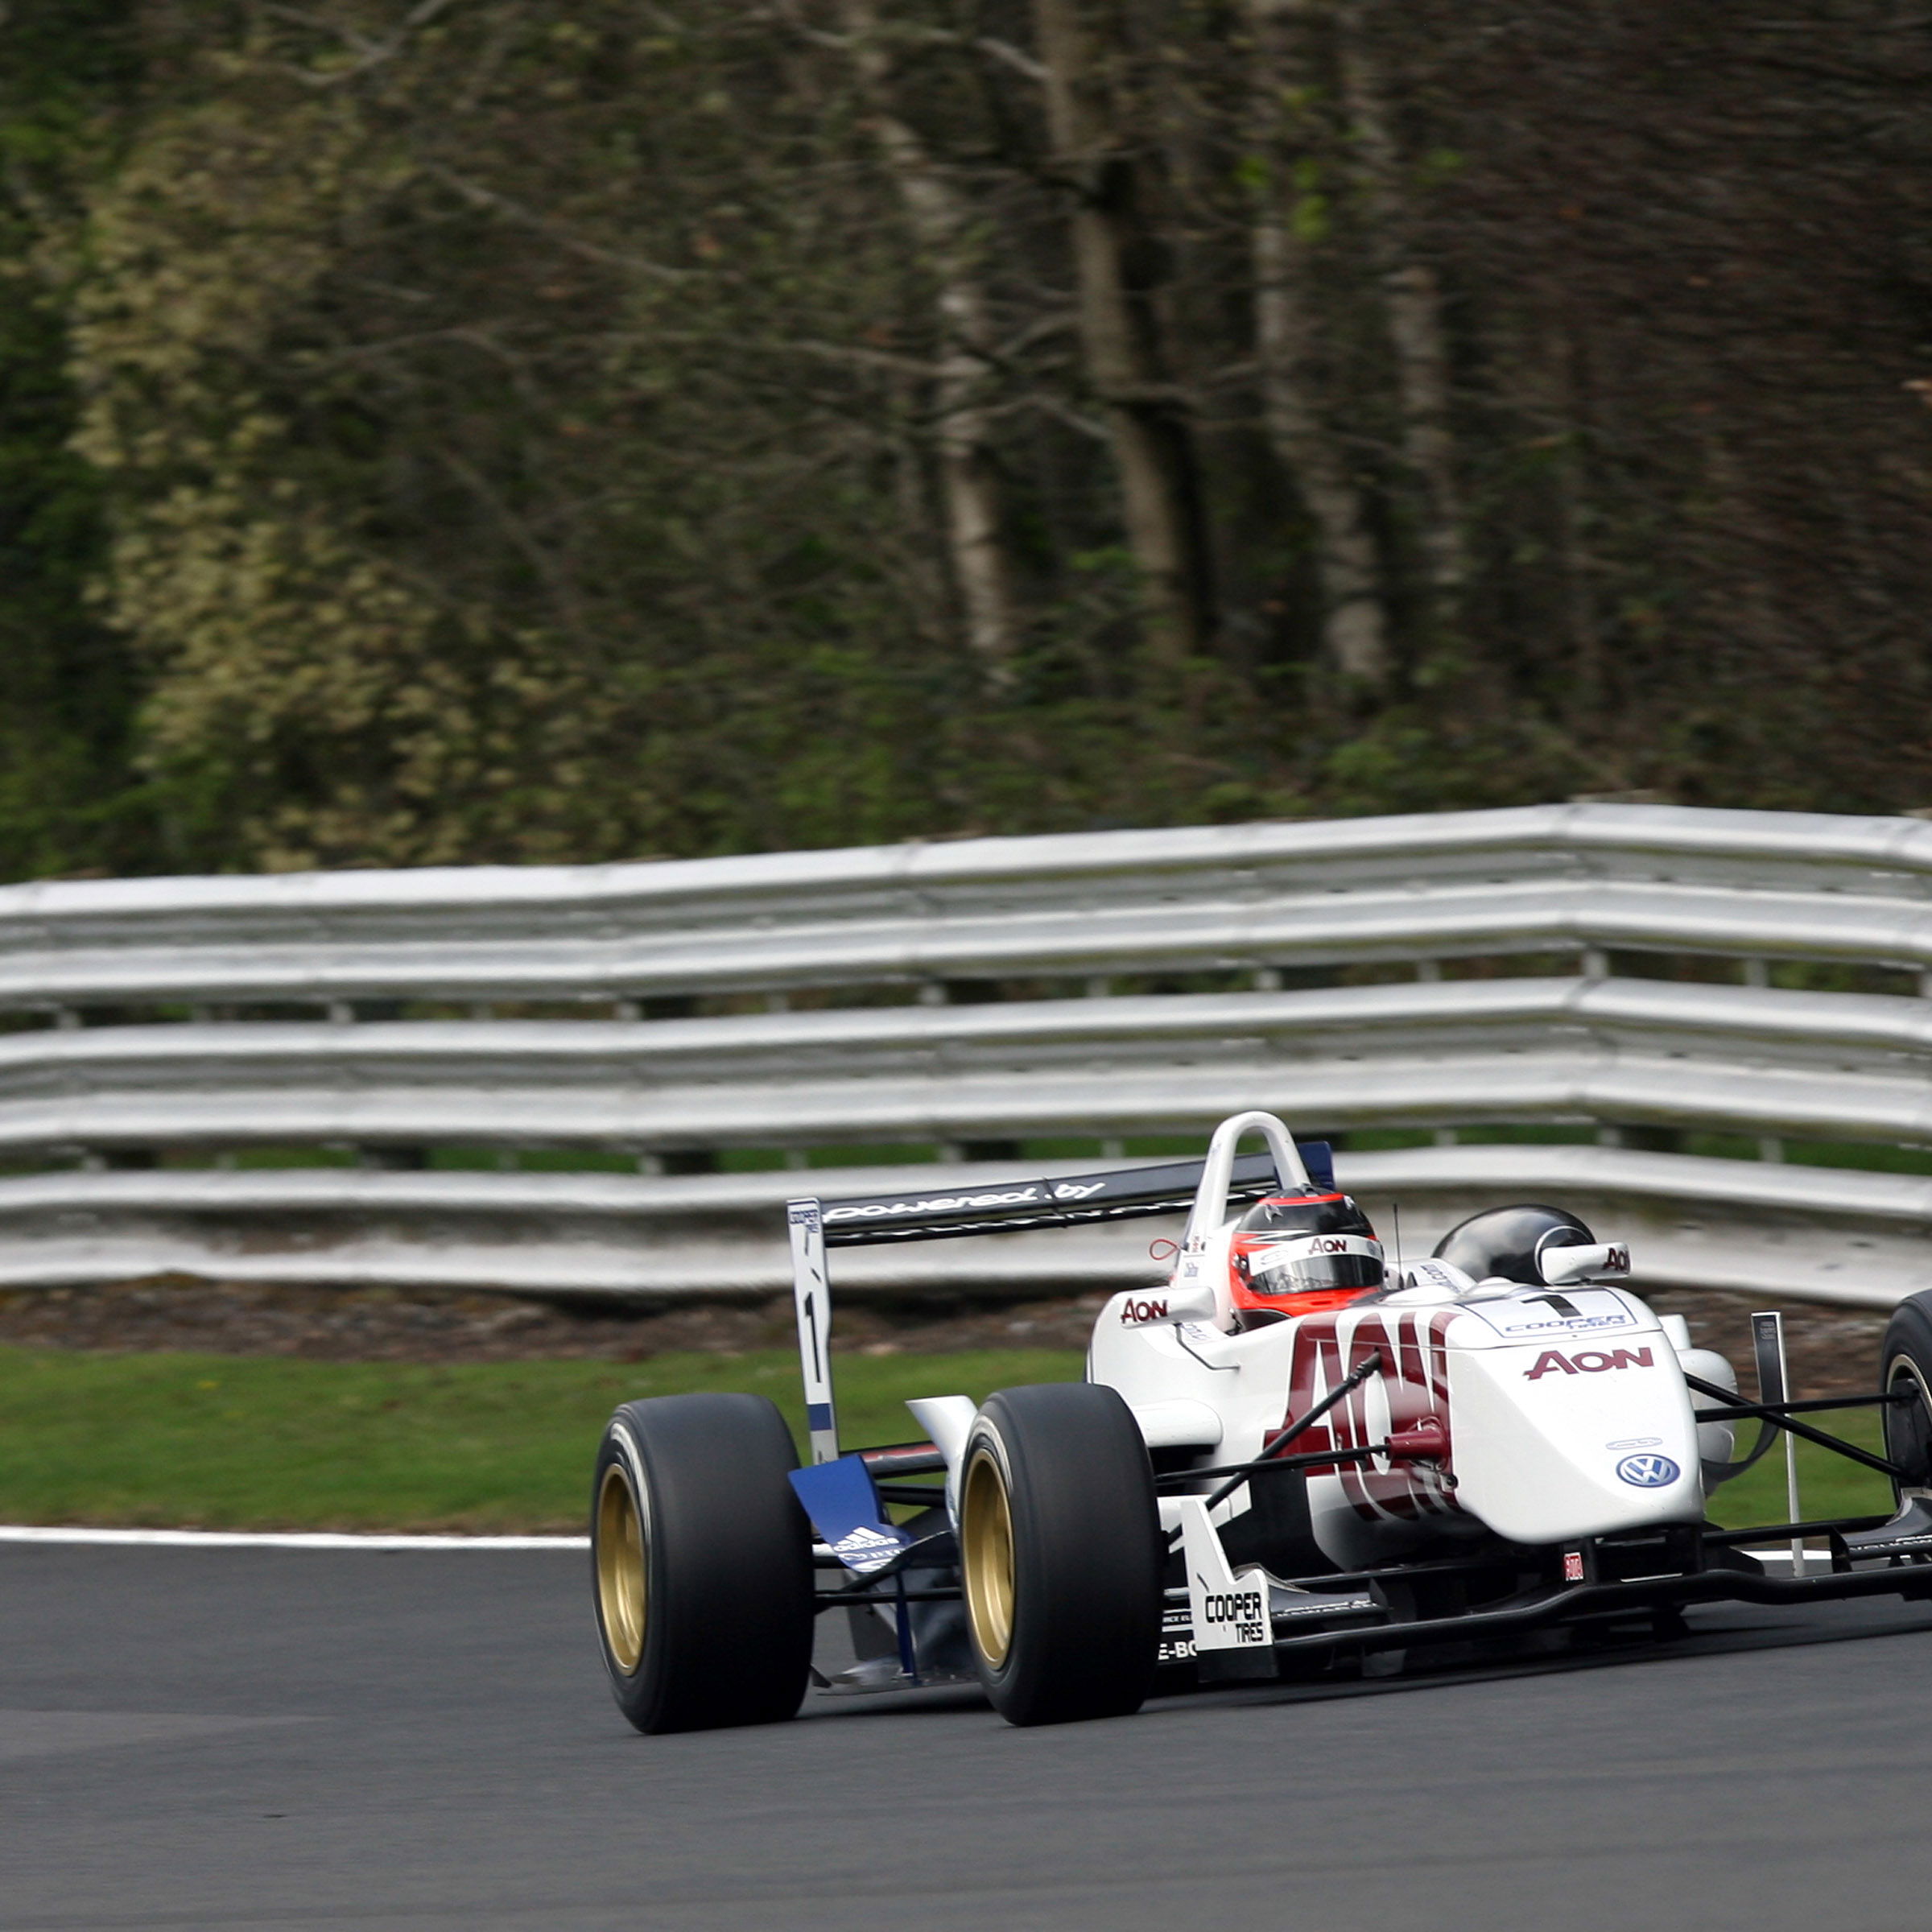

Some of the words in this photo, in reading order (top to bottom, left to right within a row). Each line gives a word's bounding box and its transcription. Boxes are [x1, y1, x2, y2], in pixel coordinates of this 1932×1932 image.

[1307, 1237, 1348, 1255] AON
[1120, 1297, 1169, 1324] AON
[1520, 1294, 1583, 1318] 1
[1505, 1315, 1626, 1332] COOPER
[1522, 1347, 1655, 1381] AON
[832, 1537, 900, 1552] adidas
[1205, 1591, 1262, 1624] COOPER
